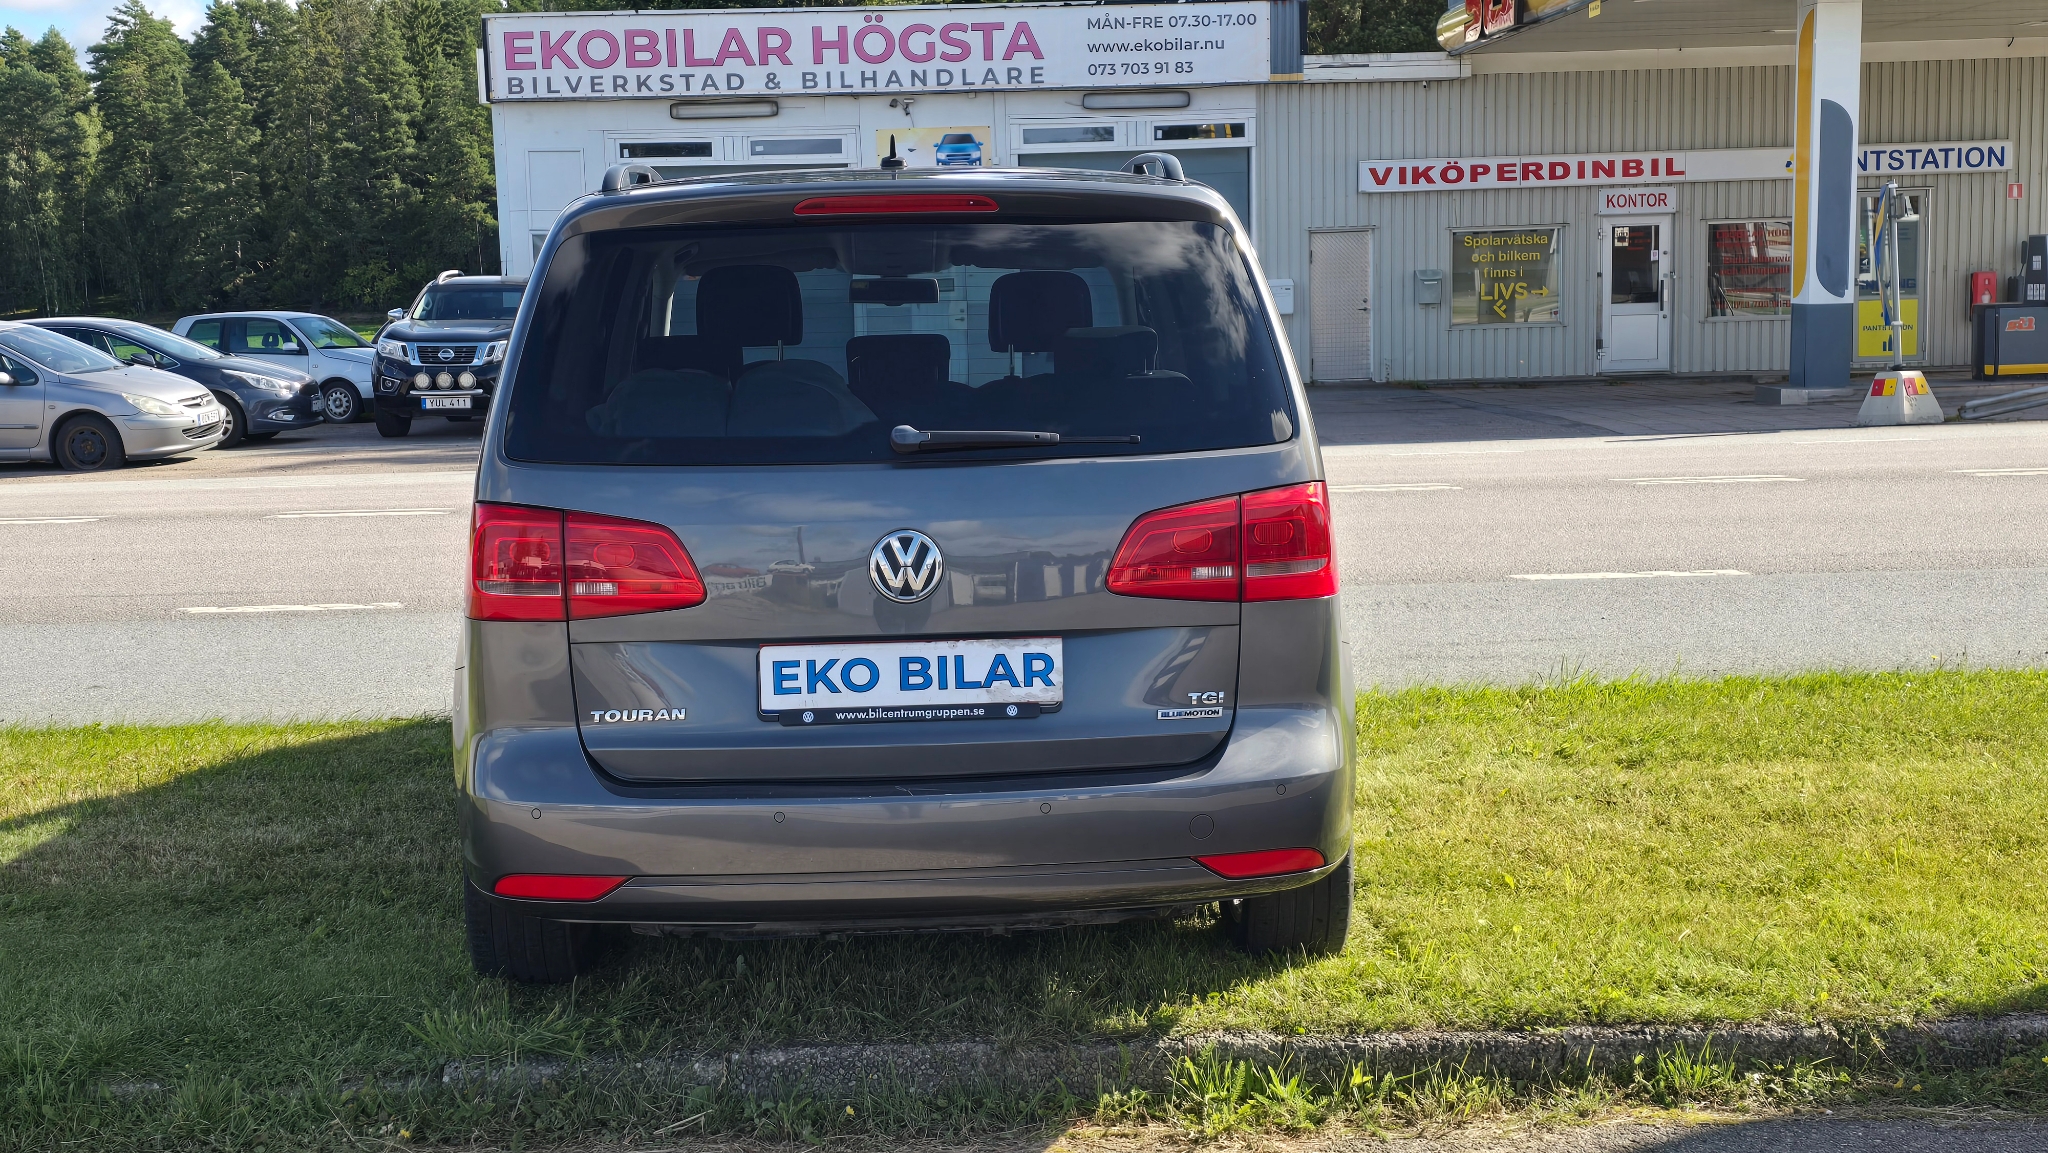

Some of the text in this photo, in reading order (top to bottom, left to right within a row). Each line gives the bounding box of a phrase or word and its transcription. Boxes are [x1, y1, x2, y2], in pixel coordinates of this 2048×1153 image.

[1086, 12, 1257, 30] MÅN-FRE 07.30-17.00
[503, 14, 1045, 71] EKOBILAR HÖGSTA
[1087, 37, 1225, 53] www.ekobilar.nu
[1087, 61, 1194, 76] 073 703 91 83
[507, 66, 1045, 95] BILVERKSTAD & BILHANDLARE
[1857, 146, 2005, 171] NTSTATION
[1606, 193, 1668, 209] KONTOR
[1463, 233, 1548, 249] Spolarvätska
[1471, 250, 1540, 263] och bilkem
[1483, 266, 1524, 278] finns i
[1480, 282, 1528, 300] LIVS
[429, 398, 447, 407] YUL
[772, 652, 1056, 696] EKO BILAR
[1187, 691, 1225, 705] TGI
[590, 707, 687, 723] TOURAN
[835, 705, 985, 722] www.bilcentrumgruppen.se
[1160, 709, 1220, 718] BLUEMOTION
